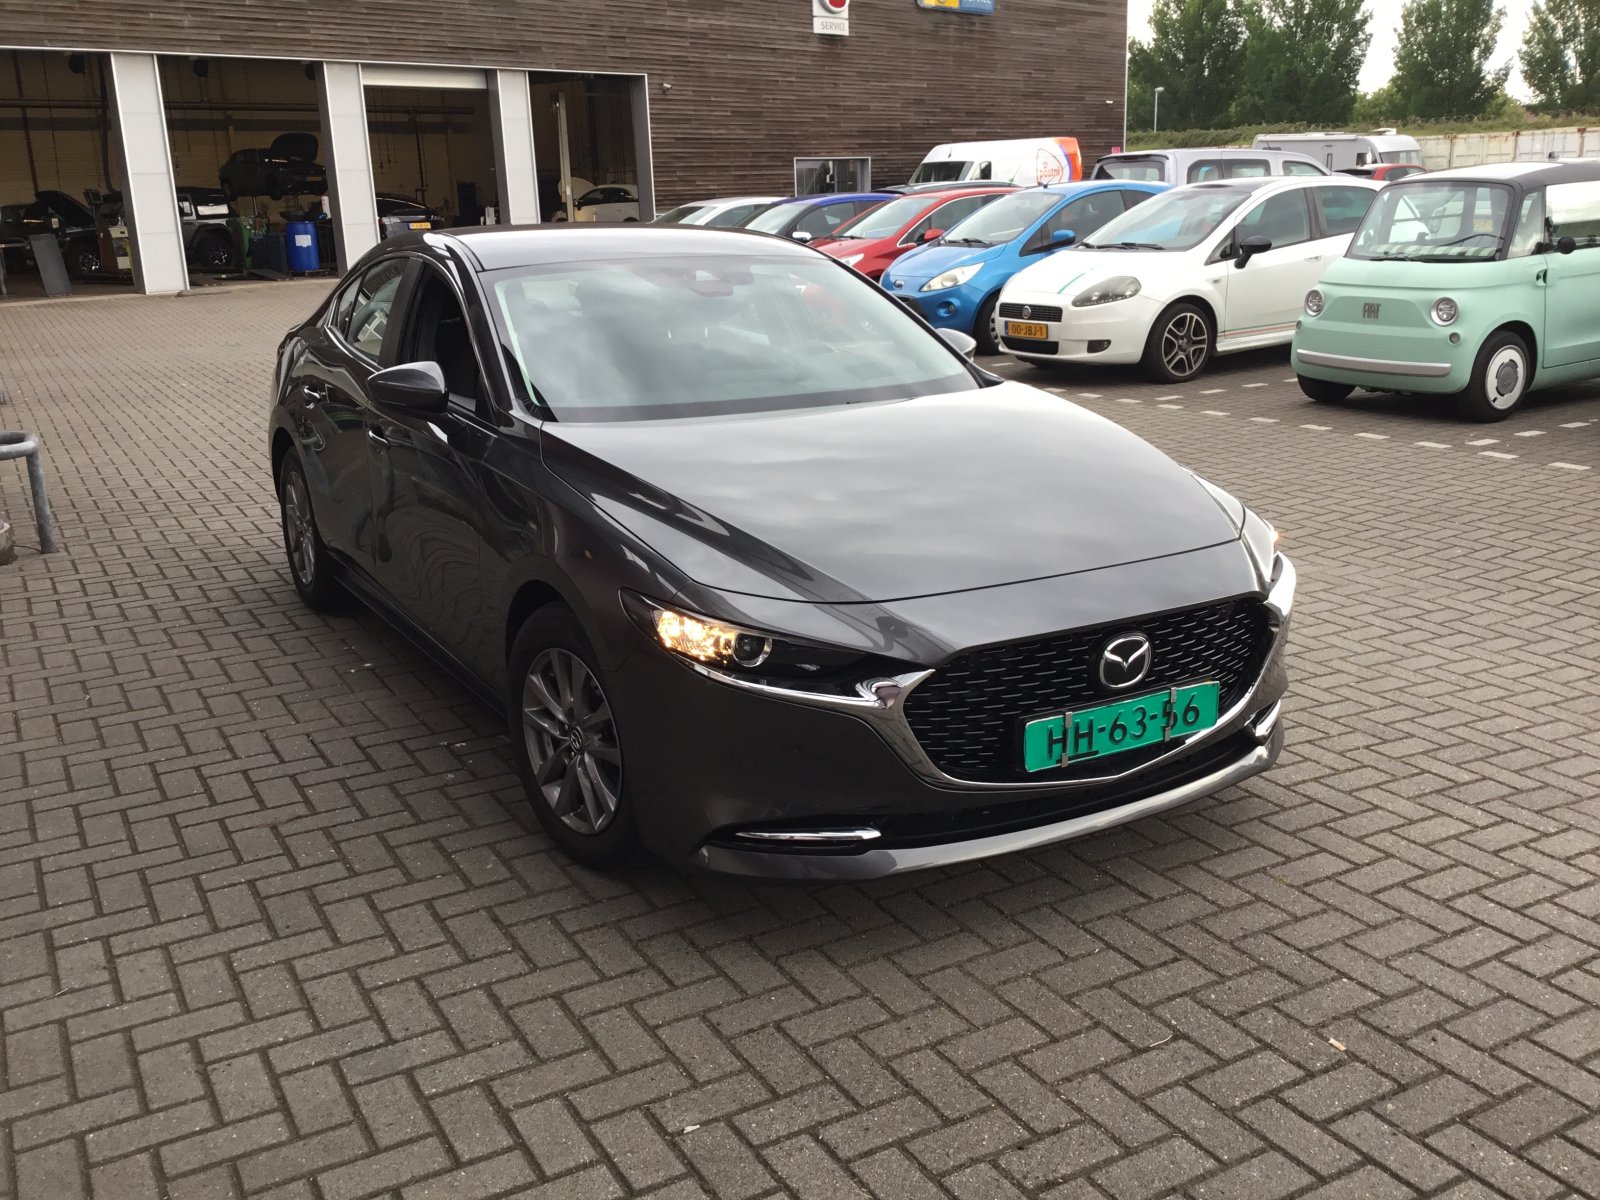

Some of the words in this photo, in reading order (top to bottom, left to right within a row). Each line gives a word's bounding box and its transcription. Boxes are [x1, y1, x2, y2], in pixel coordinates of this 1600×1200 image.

[820, 21, 846, 32] SERVICE
[1362, 302, 1381, 320] FIAT
[1047, 693, 1200, 760] HH-63-56
